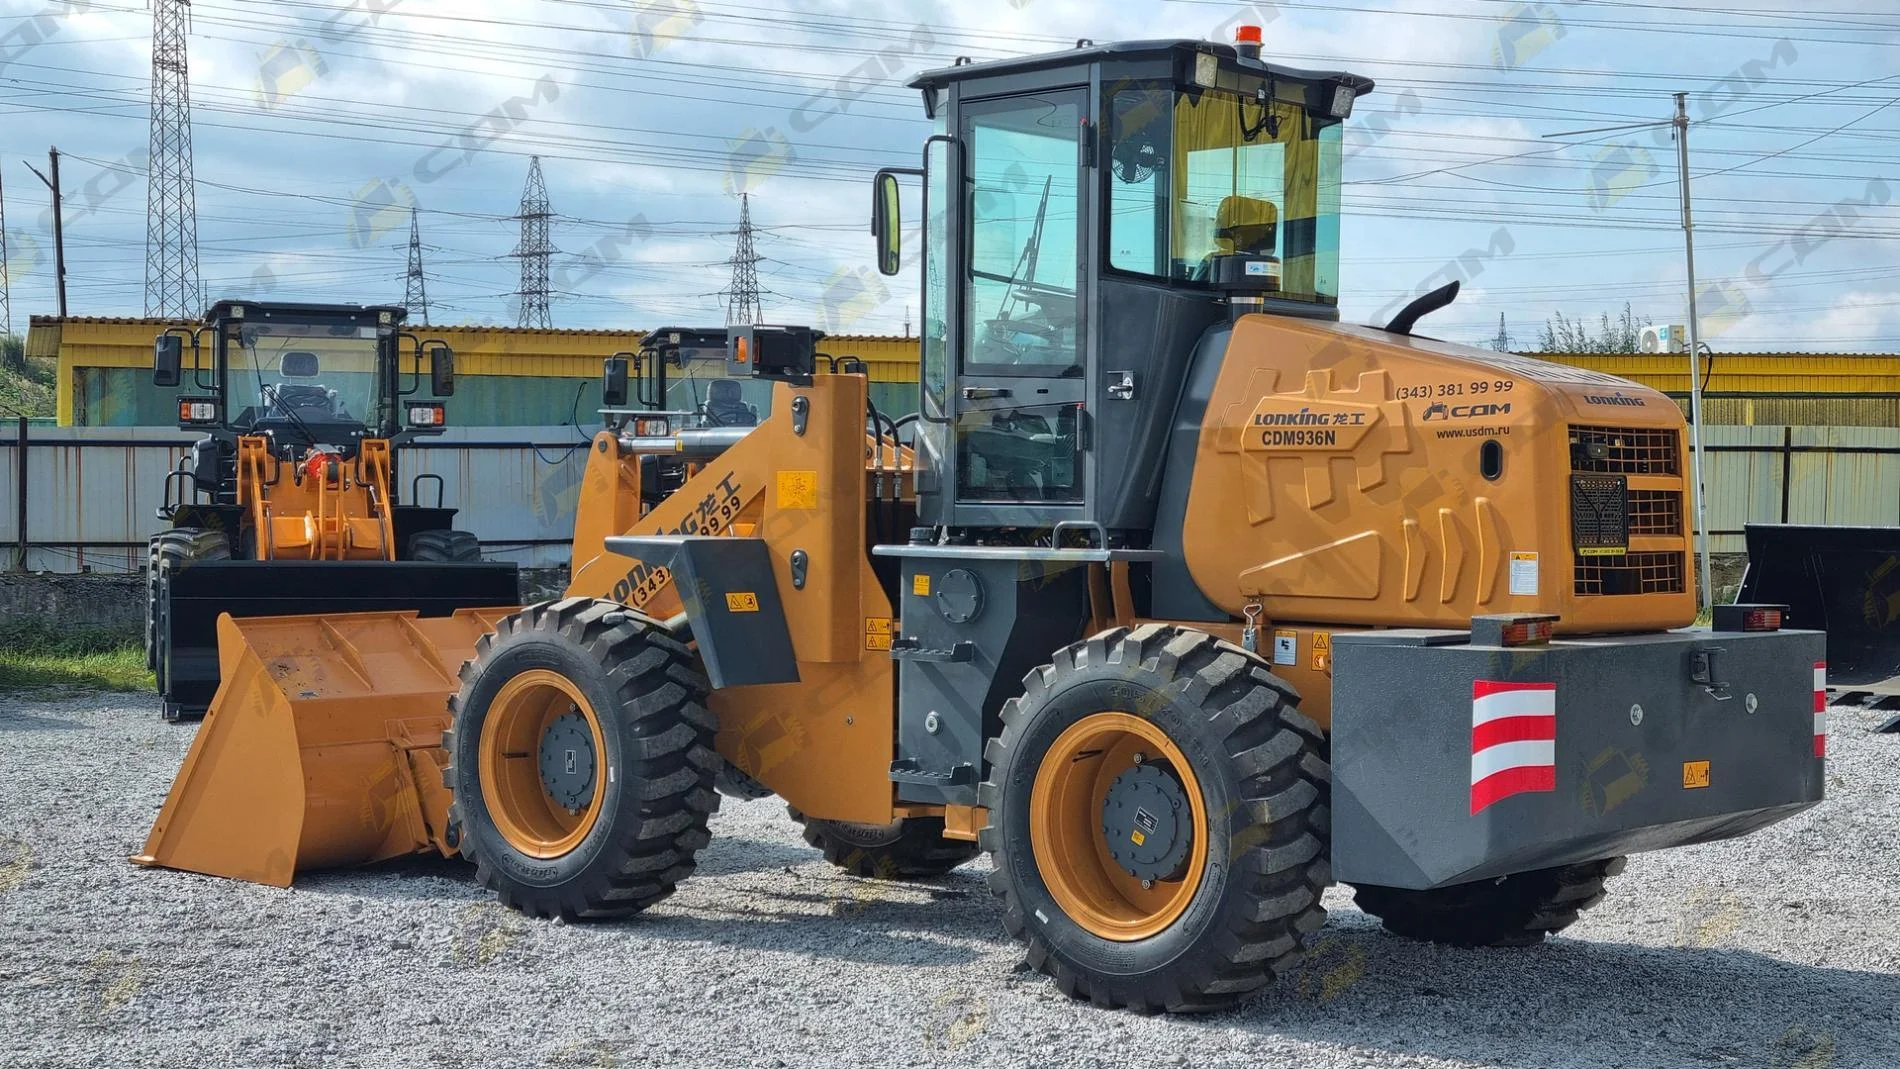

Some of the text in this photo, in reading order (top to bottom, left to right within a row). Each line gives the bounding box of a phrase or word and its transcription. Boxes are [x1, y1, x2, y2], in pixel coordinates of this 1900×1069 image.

[1396, 380, 1514, 400] (343) 381 99 99
[1333, 412, 1365, 426] 龙工
[1262, 429, 1336, 446] CDM936N
[1436, 425, 1510, 440] www.usdm.ru
[721, 496, 740, 520] 99
